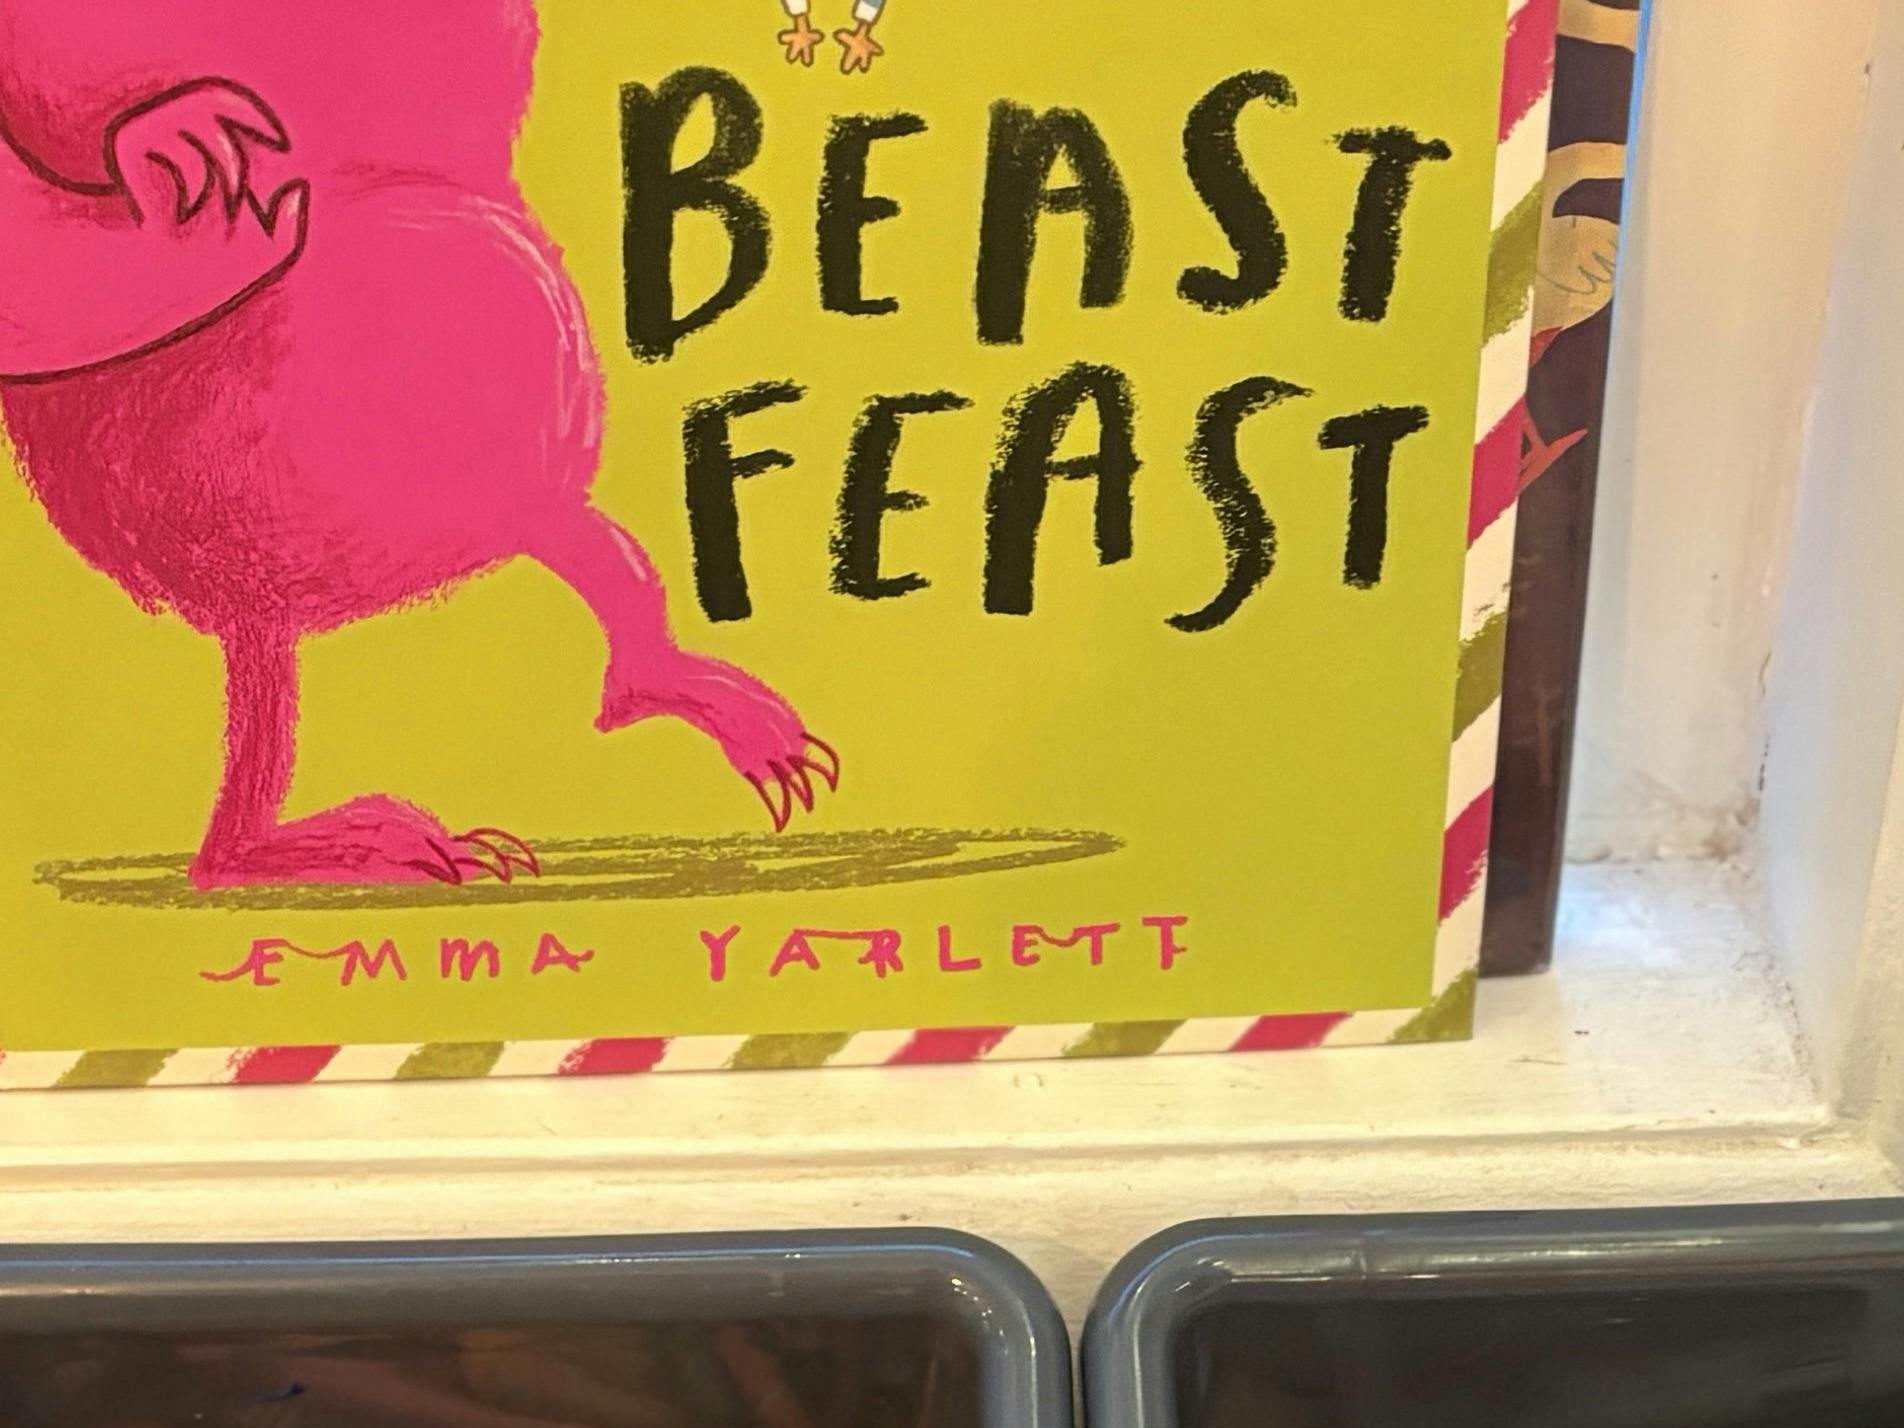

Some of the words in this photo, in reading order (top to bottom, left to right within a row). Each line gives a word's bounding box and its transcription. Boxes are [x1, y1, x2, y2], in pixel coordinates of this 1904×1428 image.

[617, 64, 1452, 364] BEAST
[682, 361, 1431, 636] FEAST
[200, 930, 598, 990] EMMA
[701, 914, 1192, 990] YARLETT
